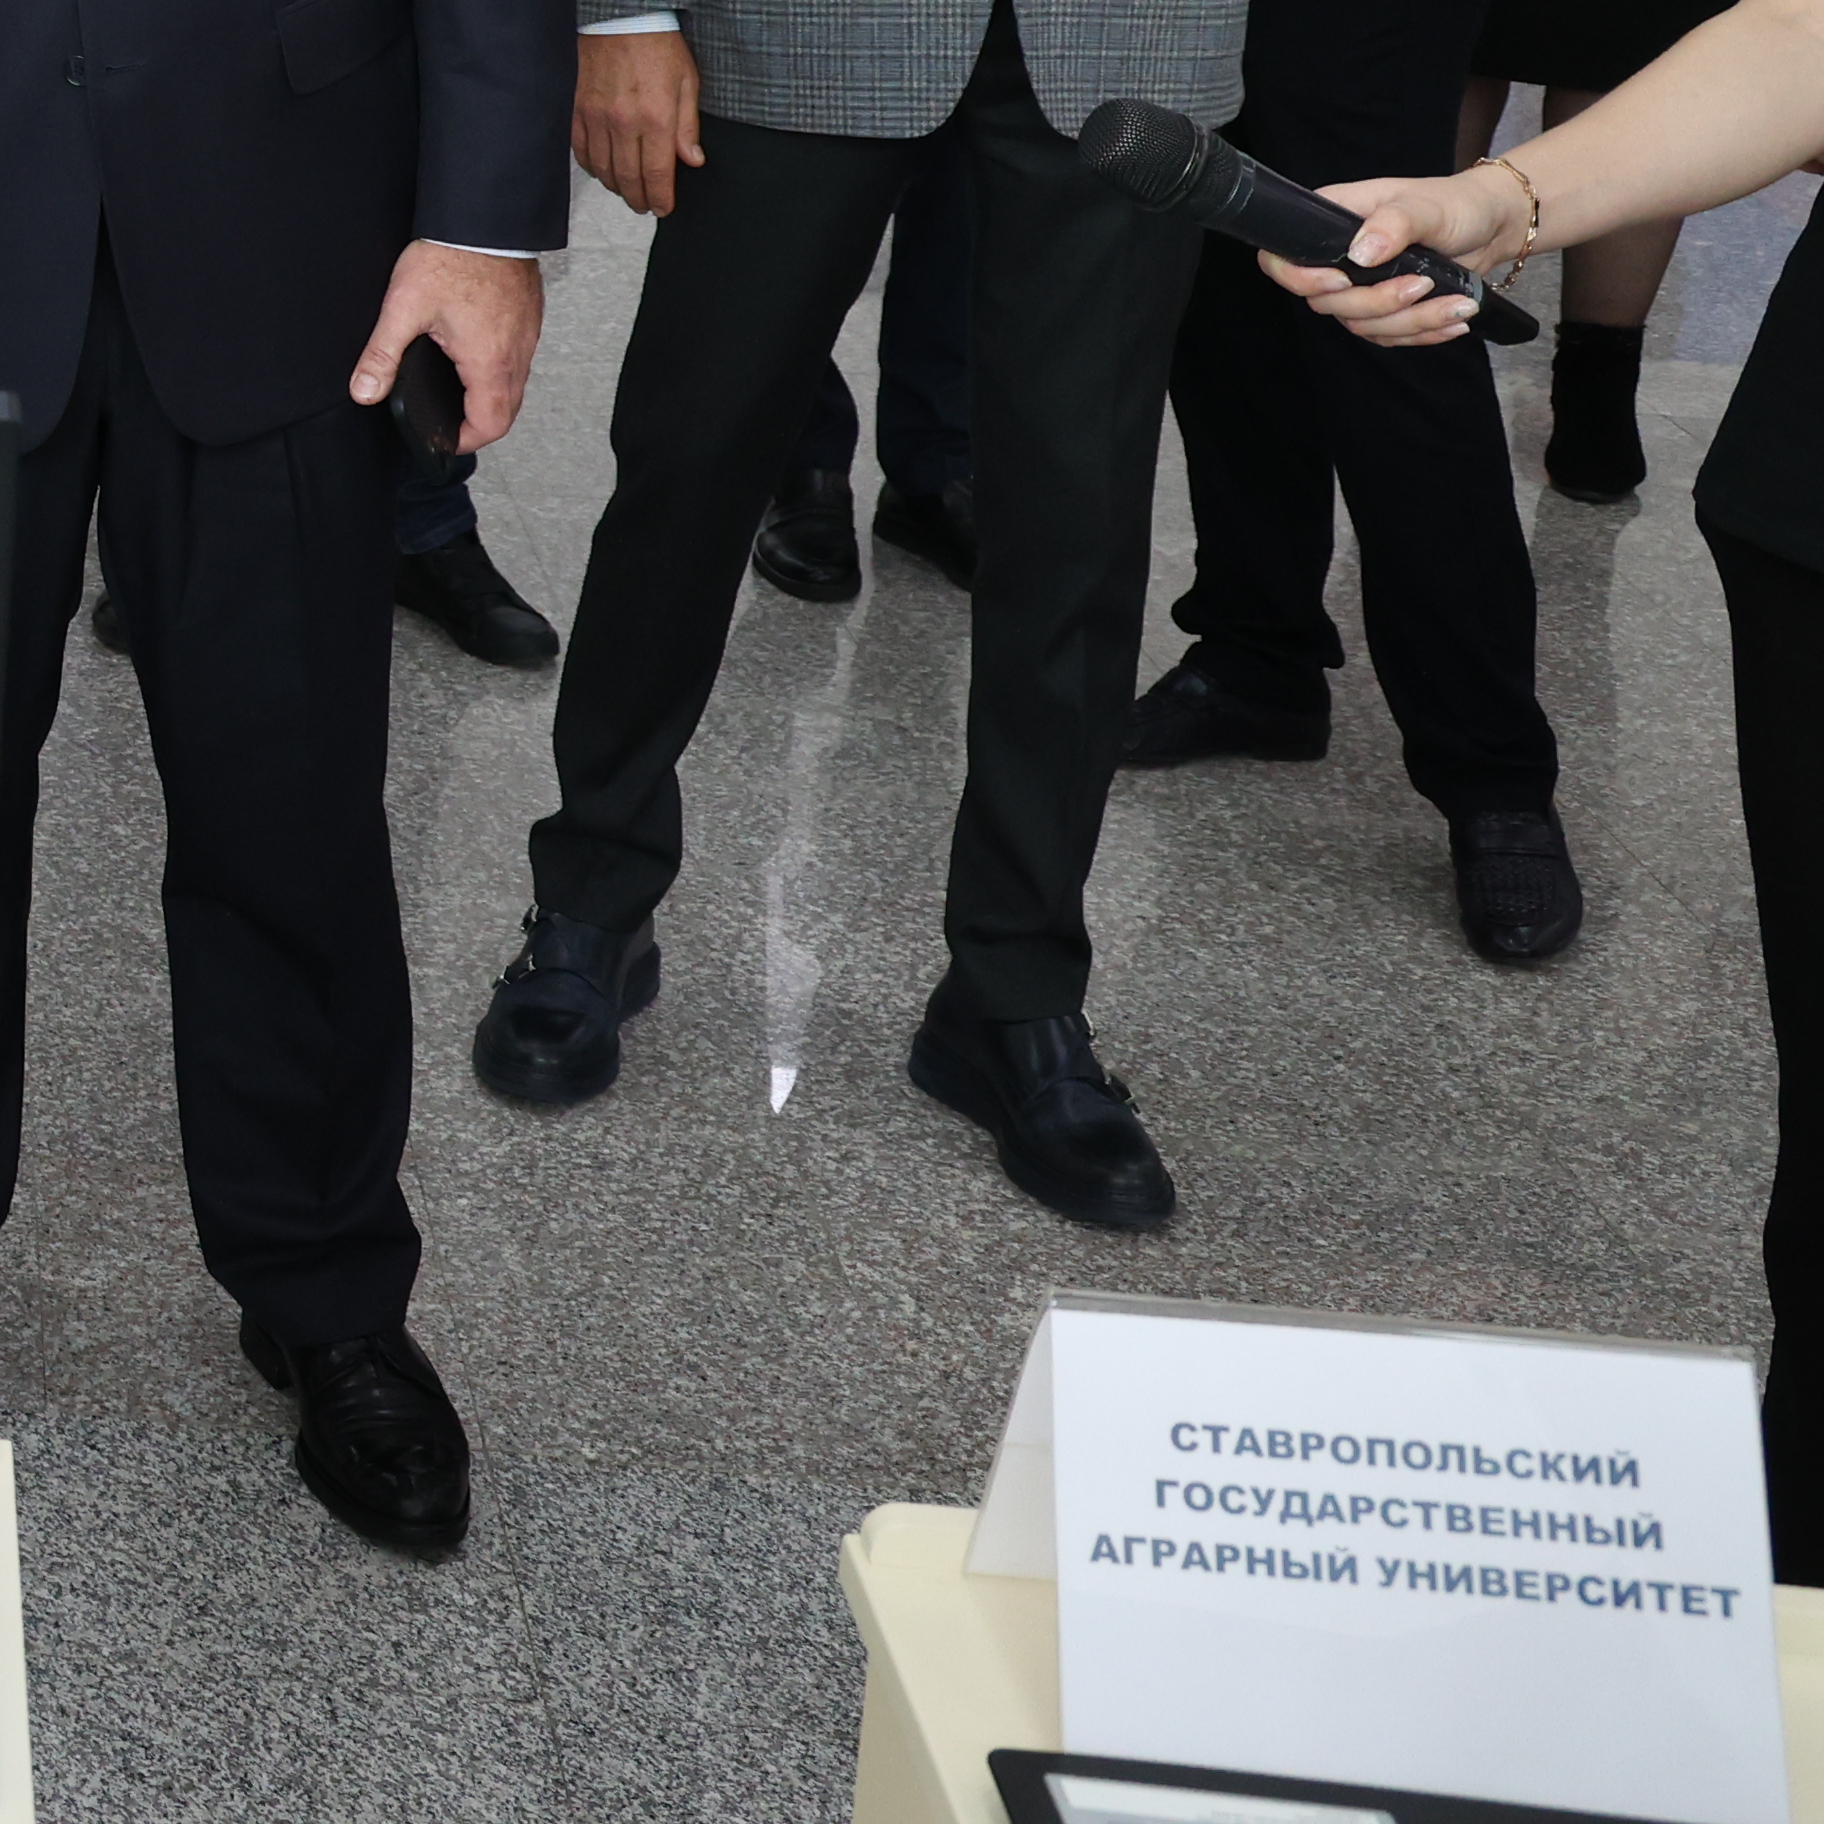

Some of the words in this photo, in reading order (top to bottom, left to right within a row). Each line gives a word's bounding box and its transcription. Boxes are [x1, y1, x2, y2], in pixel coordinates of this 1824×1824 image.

[1169, 1420, 1642, 1488] СТАВРОПОЛЬСКИЙ
[1153, 1478, 1665, 1552] ГОСУДАРСТВЕННЫЙ
[1090, 1532, 1360, 1586] АГРАРНЫЙ
[1378, 1558, 1741, 1620] УНИВЕРСИТЕТ
